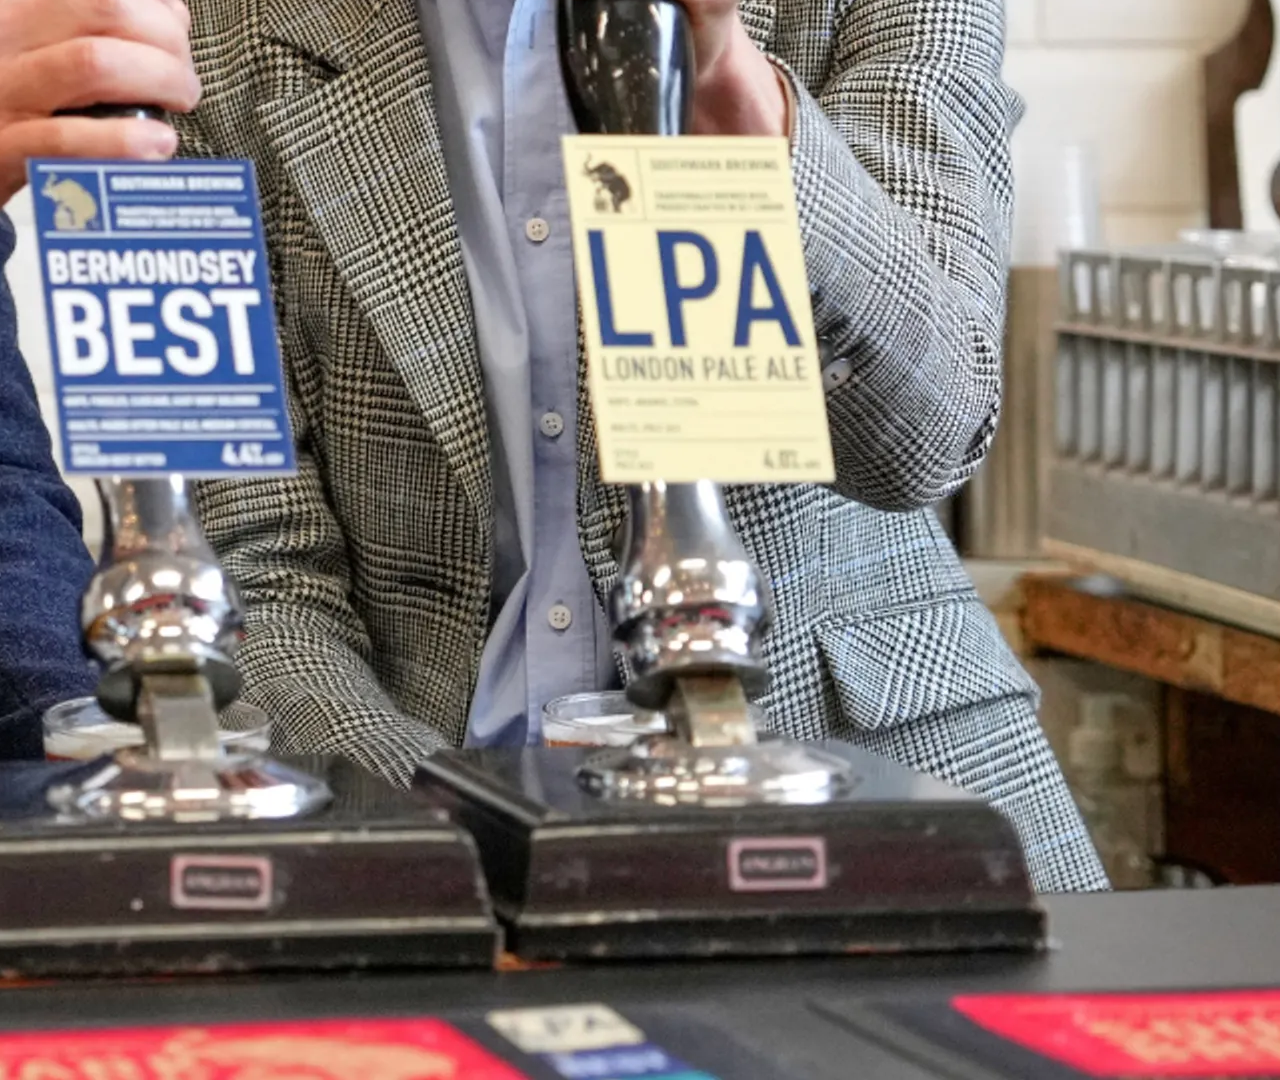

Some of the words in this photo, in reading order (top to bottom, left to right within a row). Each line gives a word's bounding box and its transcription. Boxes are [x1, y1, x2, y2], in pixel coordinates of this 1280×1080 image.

[46, 249, 257, 285] BERMONDSEY
[587, 229, 804, 347] LPA
[51, 288, 262, 376] BEST
[601, 356, 695, 382] LONDON
[701, 356, 758, 382] PALE
[765, 356, 810, 382] ALE
